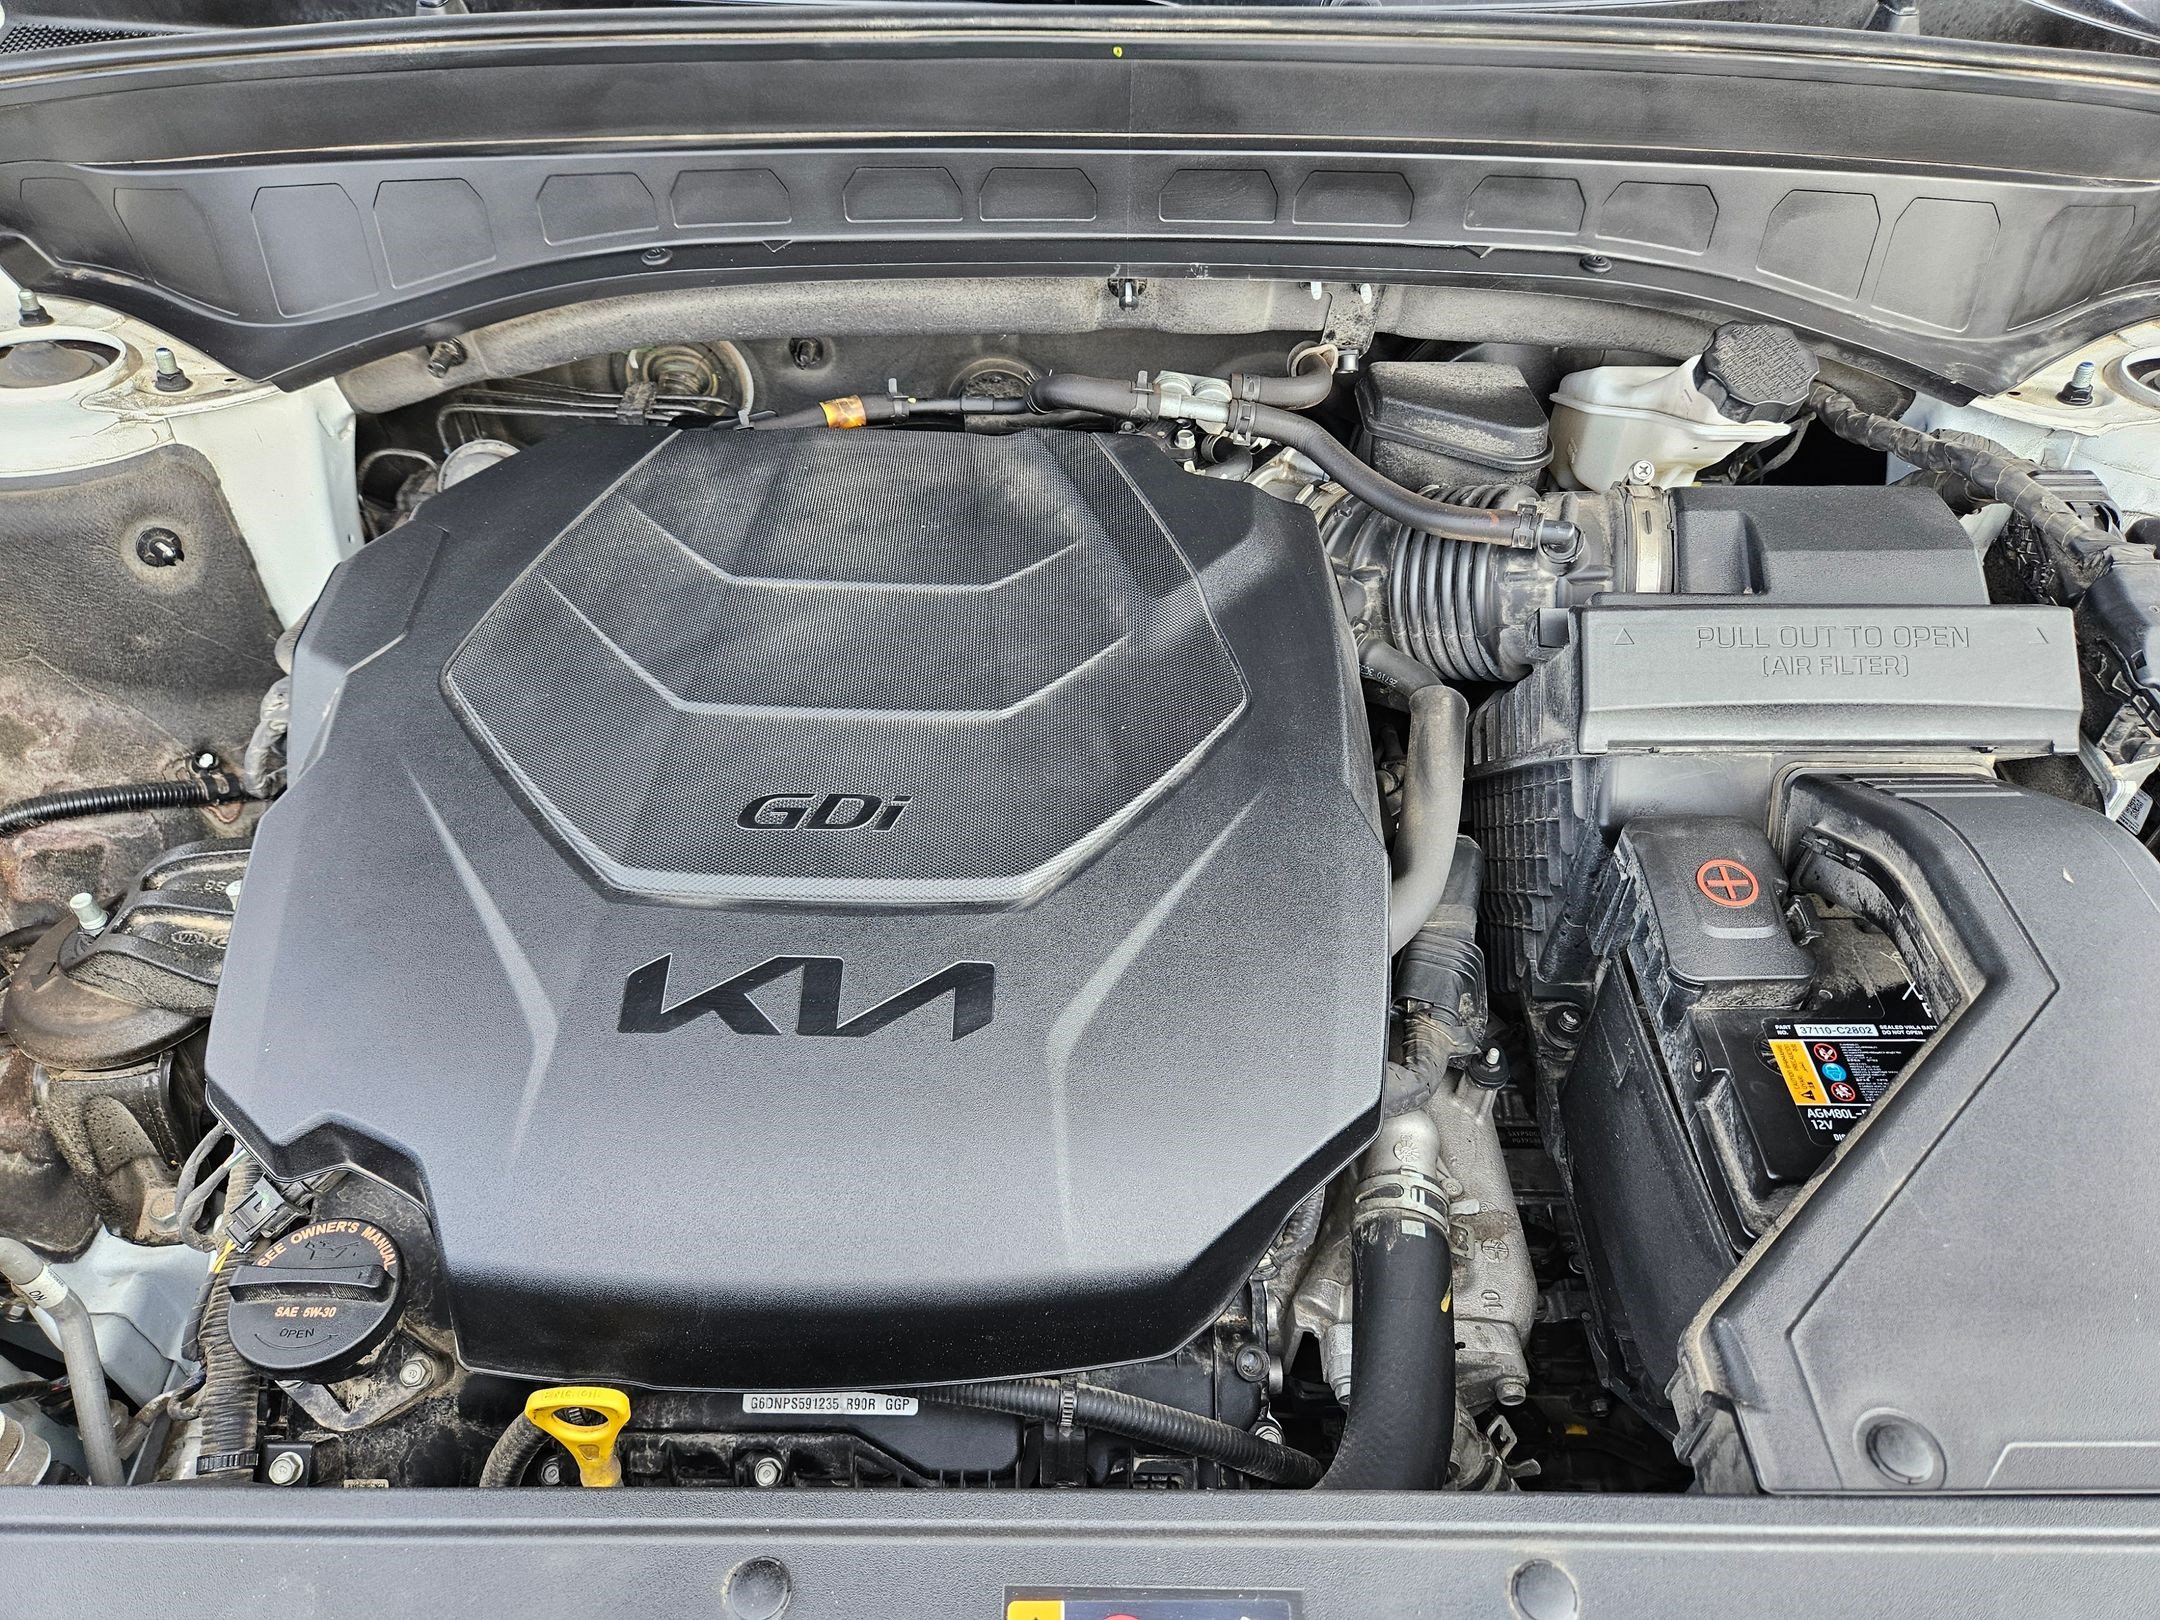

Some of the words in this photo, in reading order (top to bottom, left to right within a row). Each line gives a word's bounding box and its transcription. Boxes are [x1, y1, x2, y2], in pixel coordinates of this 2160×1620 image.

[1696, 625, 1770, 649] PULL
[1779, 625, 1836, 649] OUT
[1844, 625, 1883, 649] TO
[1893, 625, 1971, 649] OPEN
[736, 793, 912, 831] GDi
[617, 953, 996, 1042] KIA
[1800, 1026, 1874, 1035] 37110-C2802
[1811, 1119, 1833, 1130] 12V
[257, 1243, 288, 1267] SEE
[290, 1221, 361, 1245] OWNER'S
[360, 1225, 397, 1271] MANUAL
[274, 1306, 300, 1318] SAE
[279, 1327, 315, 1339] OPEN
[885, 1398, 910, 1411] GGP
